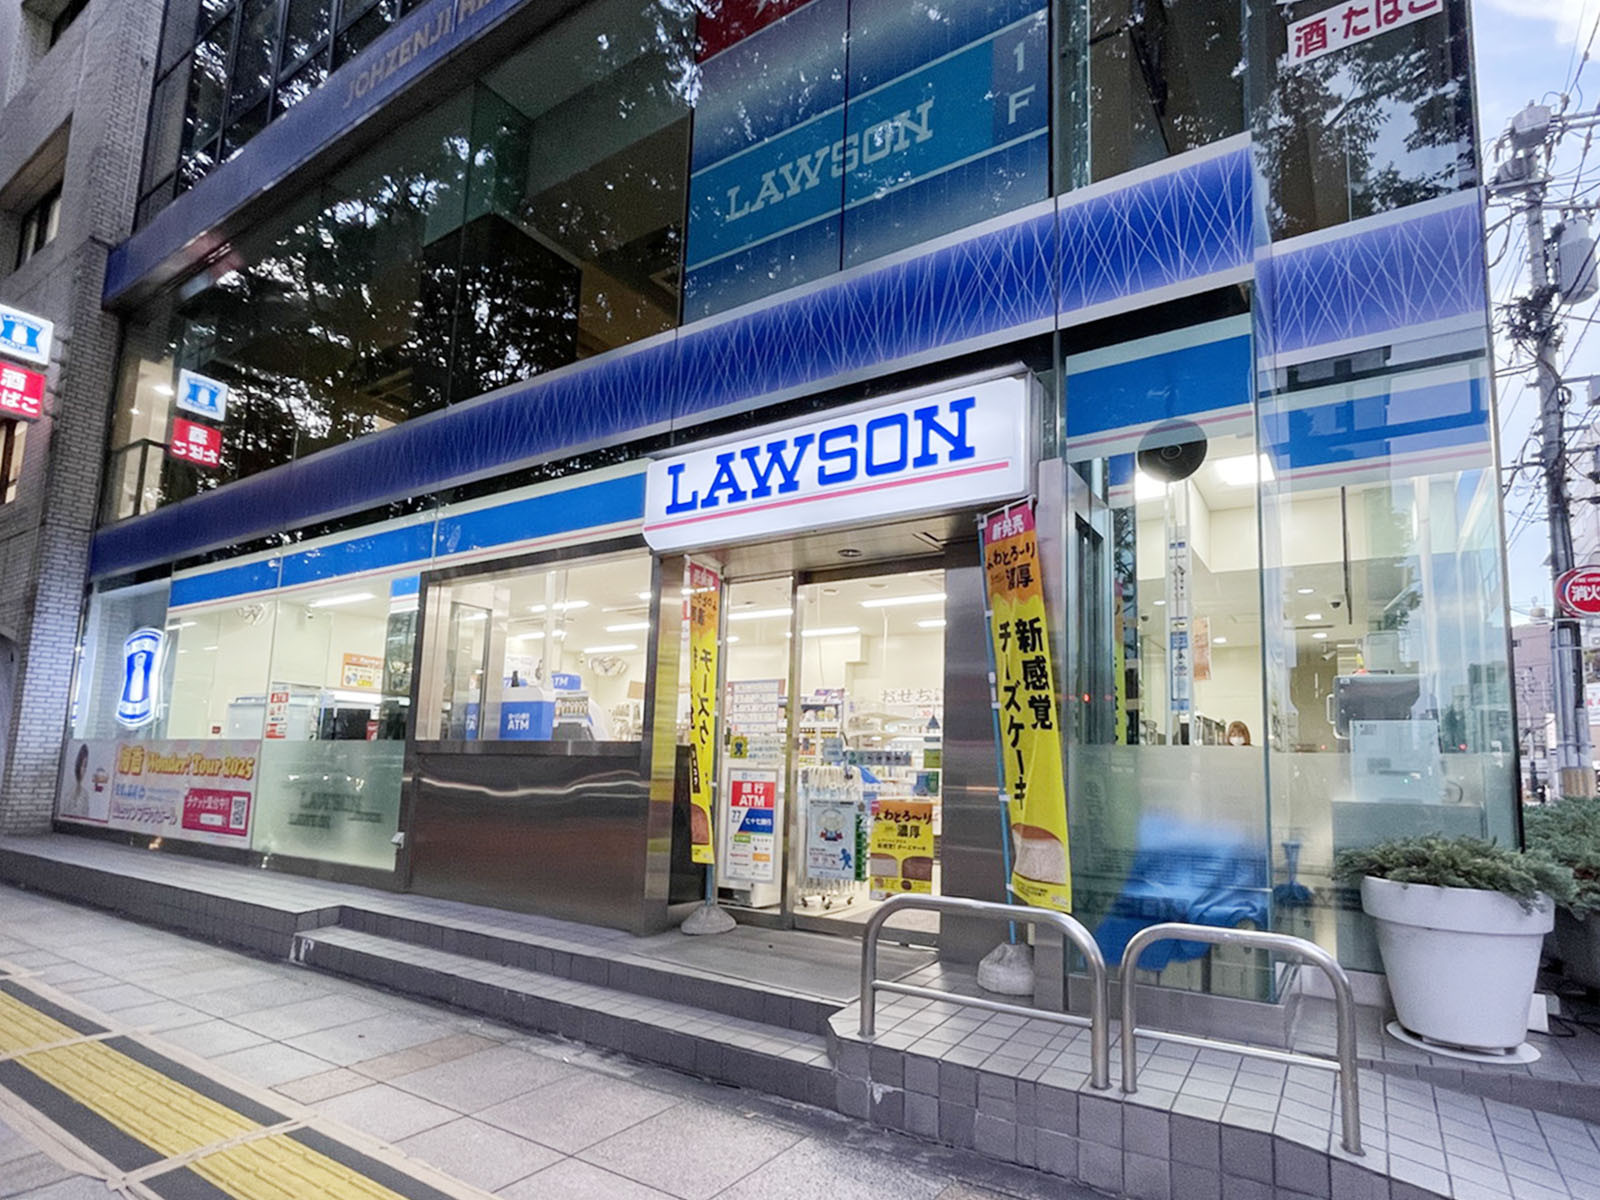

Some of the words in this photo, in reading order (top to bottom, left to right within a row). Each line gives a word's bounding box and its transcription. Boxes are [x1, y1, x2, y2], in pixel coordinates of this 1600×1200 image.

[343, 7, 451, 109] JOHZENJI
[1013, 41, 1026, 73] 1
[1007, 84, 1036, 125] F
[725, 99, 934, 223] LAWSON
[0, 368, 27, 392] 酒
[0, 389, 39, 414] ばこ
[665, 396, 976, 516] LAWSON
[991, 514, 1025, 541] 新発売
[1005, 562, 1034, 591] 濃厚
[1014, 616, 1053, 730] 新感覚
[507, 720, 530, 731] ATM
[998, 620, 1027, 810] チーズケーキ
[192, 752, 222, 778] Tour
[222, 755, 256, 781] 2025
[738, 793, 766, 808] ATM
